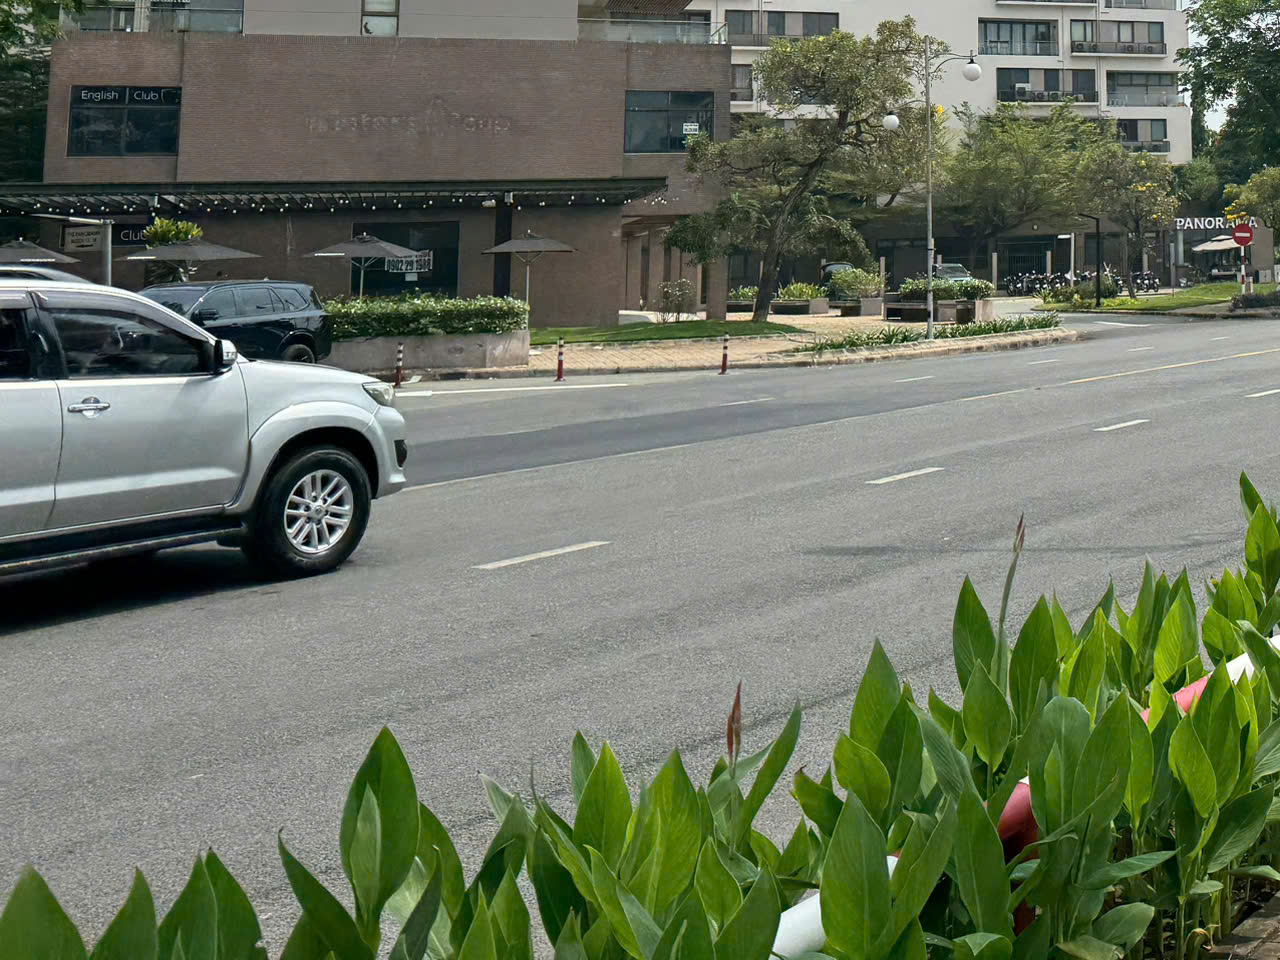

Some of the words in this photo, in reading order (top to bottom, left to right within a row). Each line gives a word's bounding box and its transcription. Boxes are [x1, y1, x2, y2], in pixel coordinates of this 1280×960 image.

[81, 90, 119, 101] English
[133, 90, 159, 100] Club
[1175, 216, 1259, 230] PANORAA
